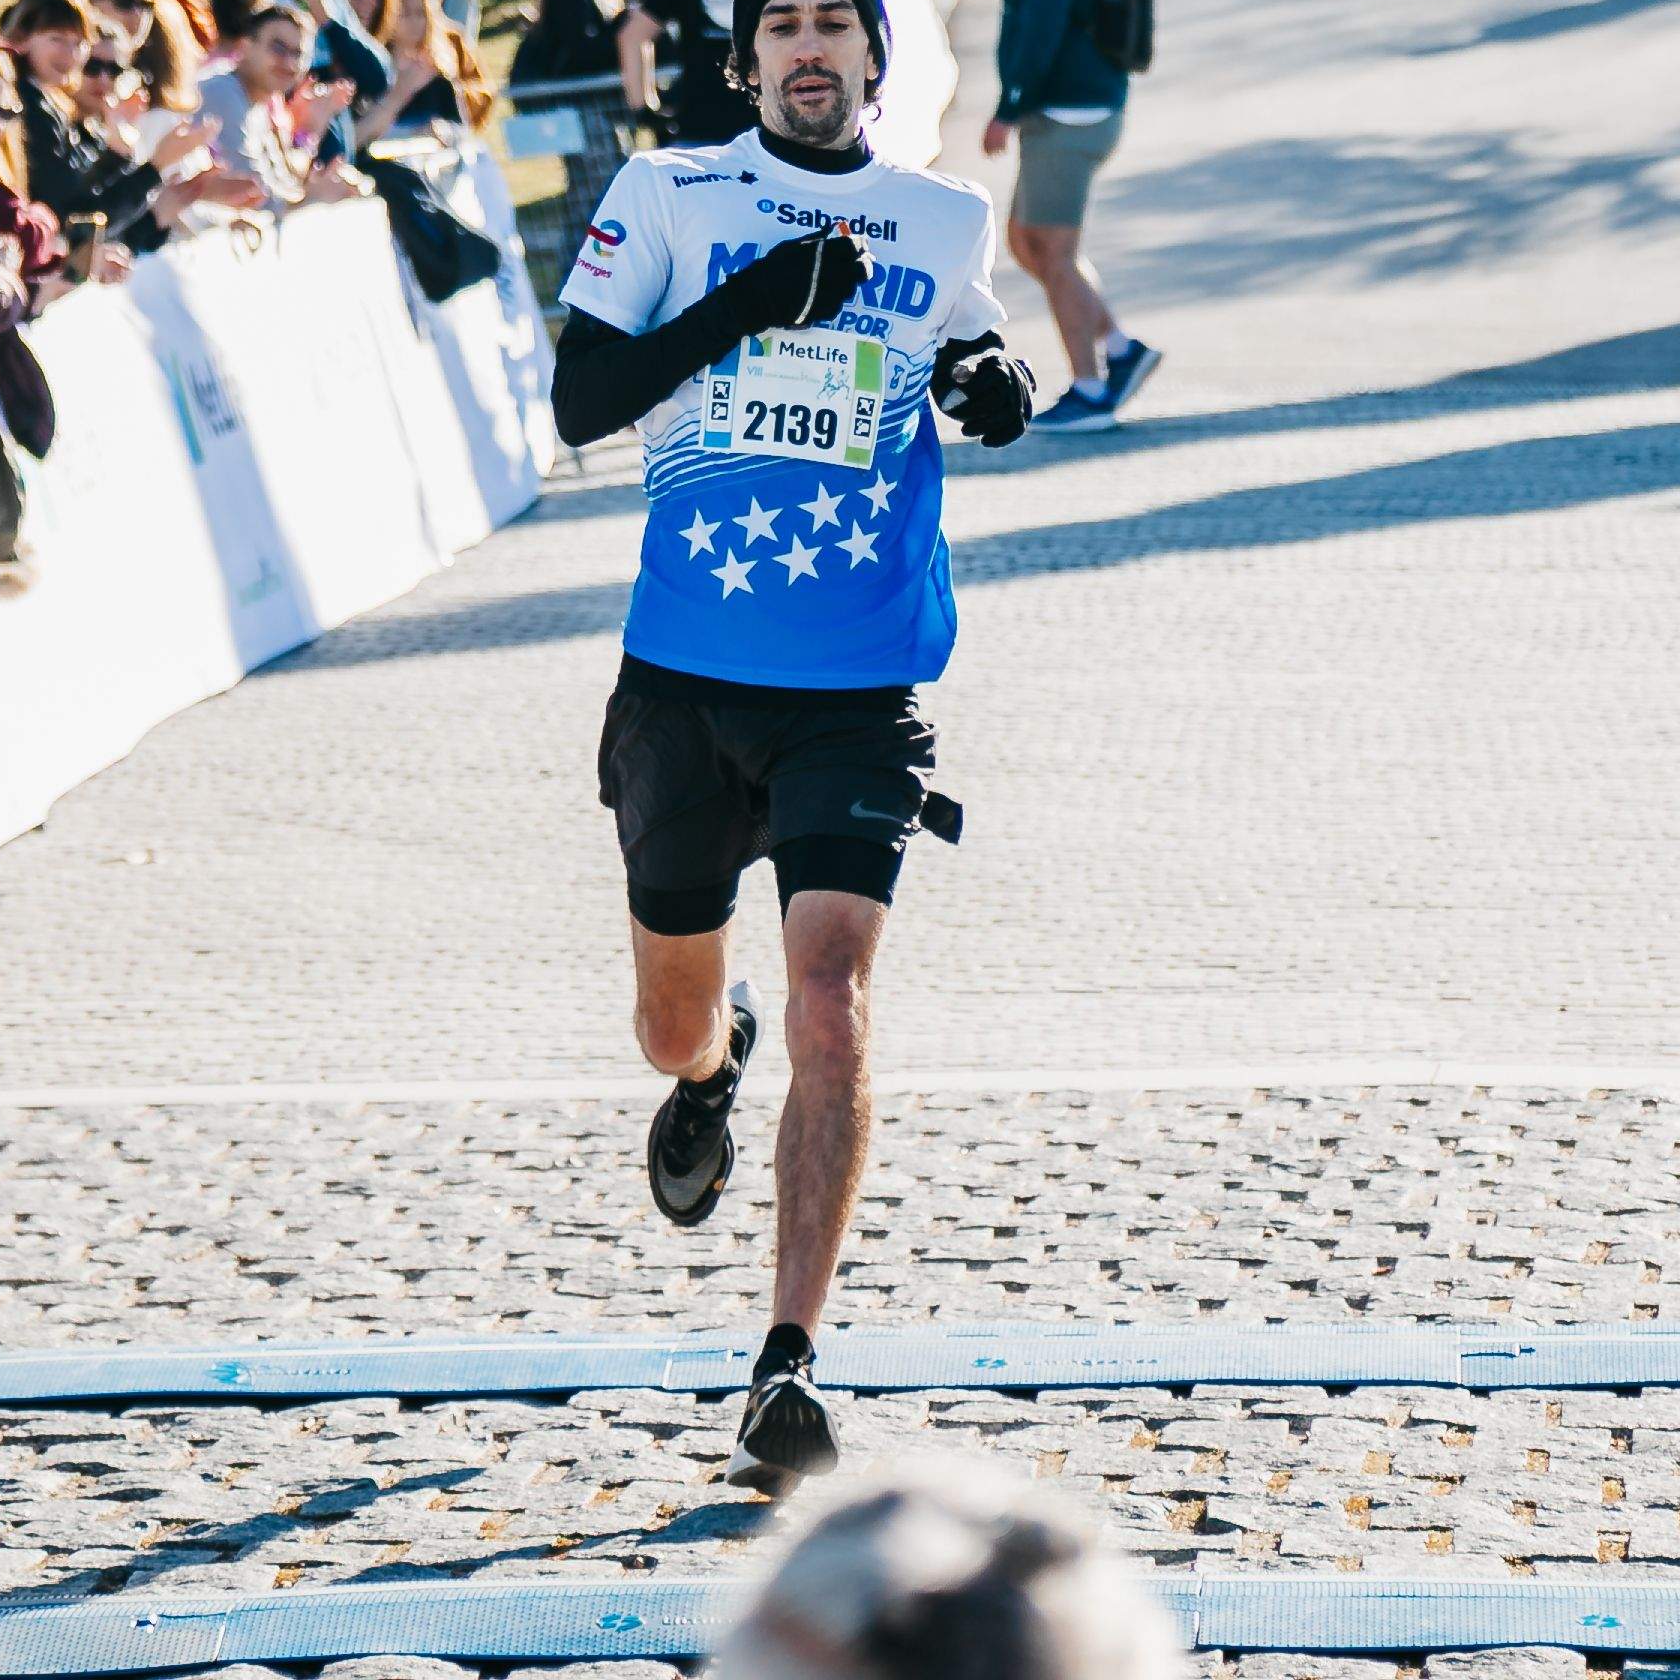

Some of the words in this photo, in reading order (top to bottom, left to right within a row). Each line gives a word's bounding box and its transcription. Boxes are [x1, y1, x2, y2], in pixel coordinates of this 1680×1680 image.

[705, 242, 937, 319] MRID
[837, 312, 889, 339] POR
[779, 341, 849, 365] MetLife
[742, 400, 839, 450] 2139
